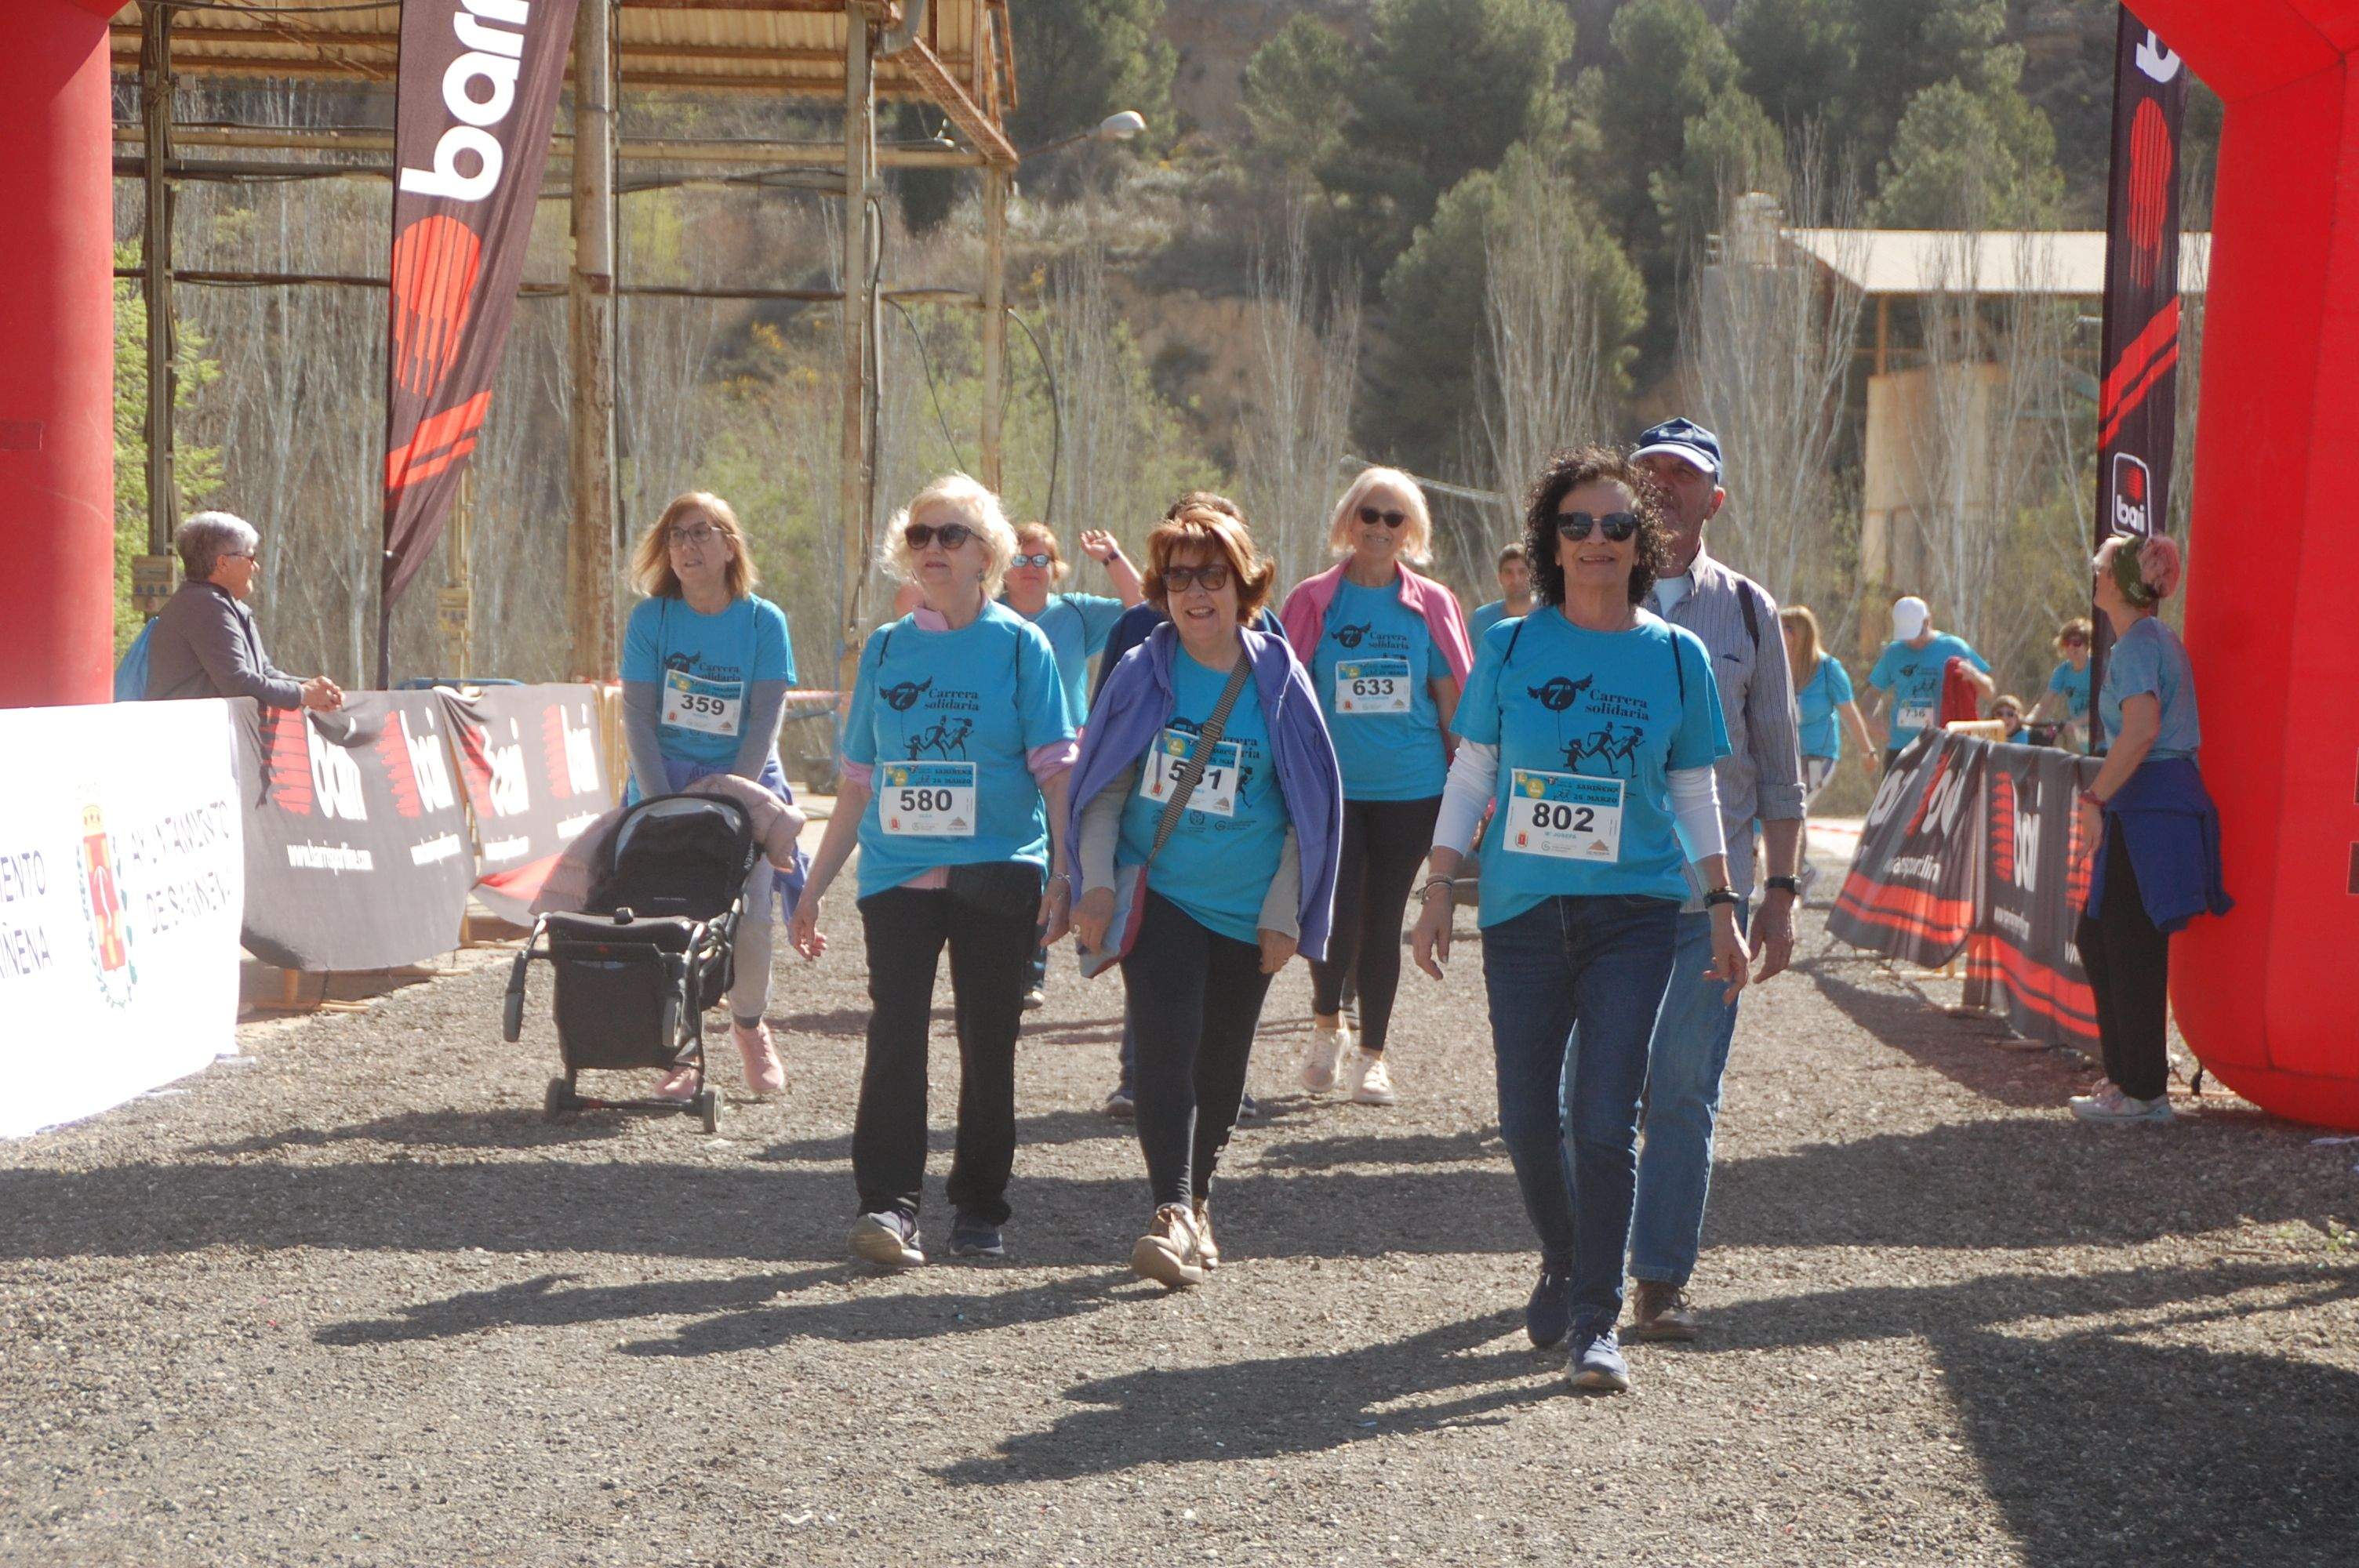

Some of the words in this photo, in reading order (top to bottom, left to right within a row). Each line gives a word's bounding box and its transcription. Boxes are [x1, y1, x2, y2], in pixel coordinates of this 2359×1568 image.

[929, 688, 979, 699] Carrera
[1352, 678, 1394, 696] 633
[680, 694, 725, 716] 359
[924, 698, 980, 711] solidaria
[1589, 688, 1648, 709] Carrera
[1584, 702, 1650, 721] solidaria
[900, 789, 953, 811] 580
[1532, 801, 1594, 833] 802
